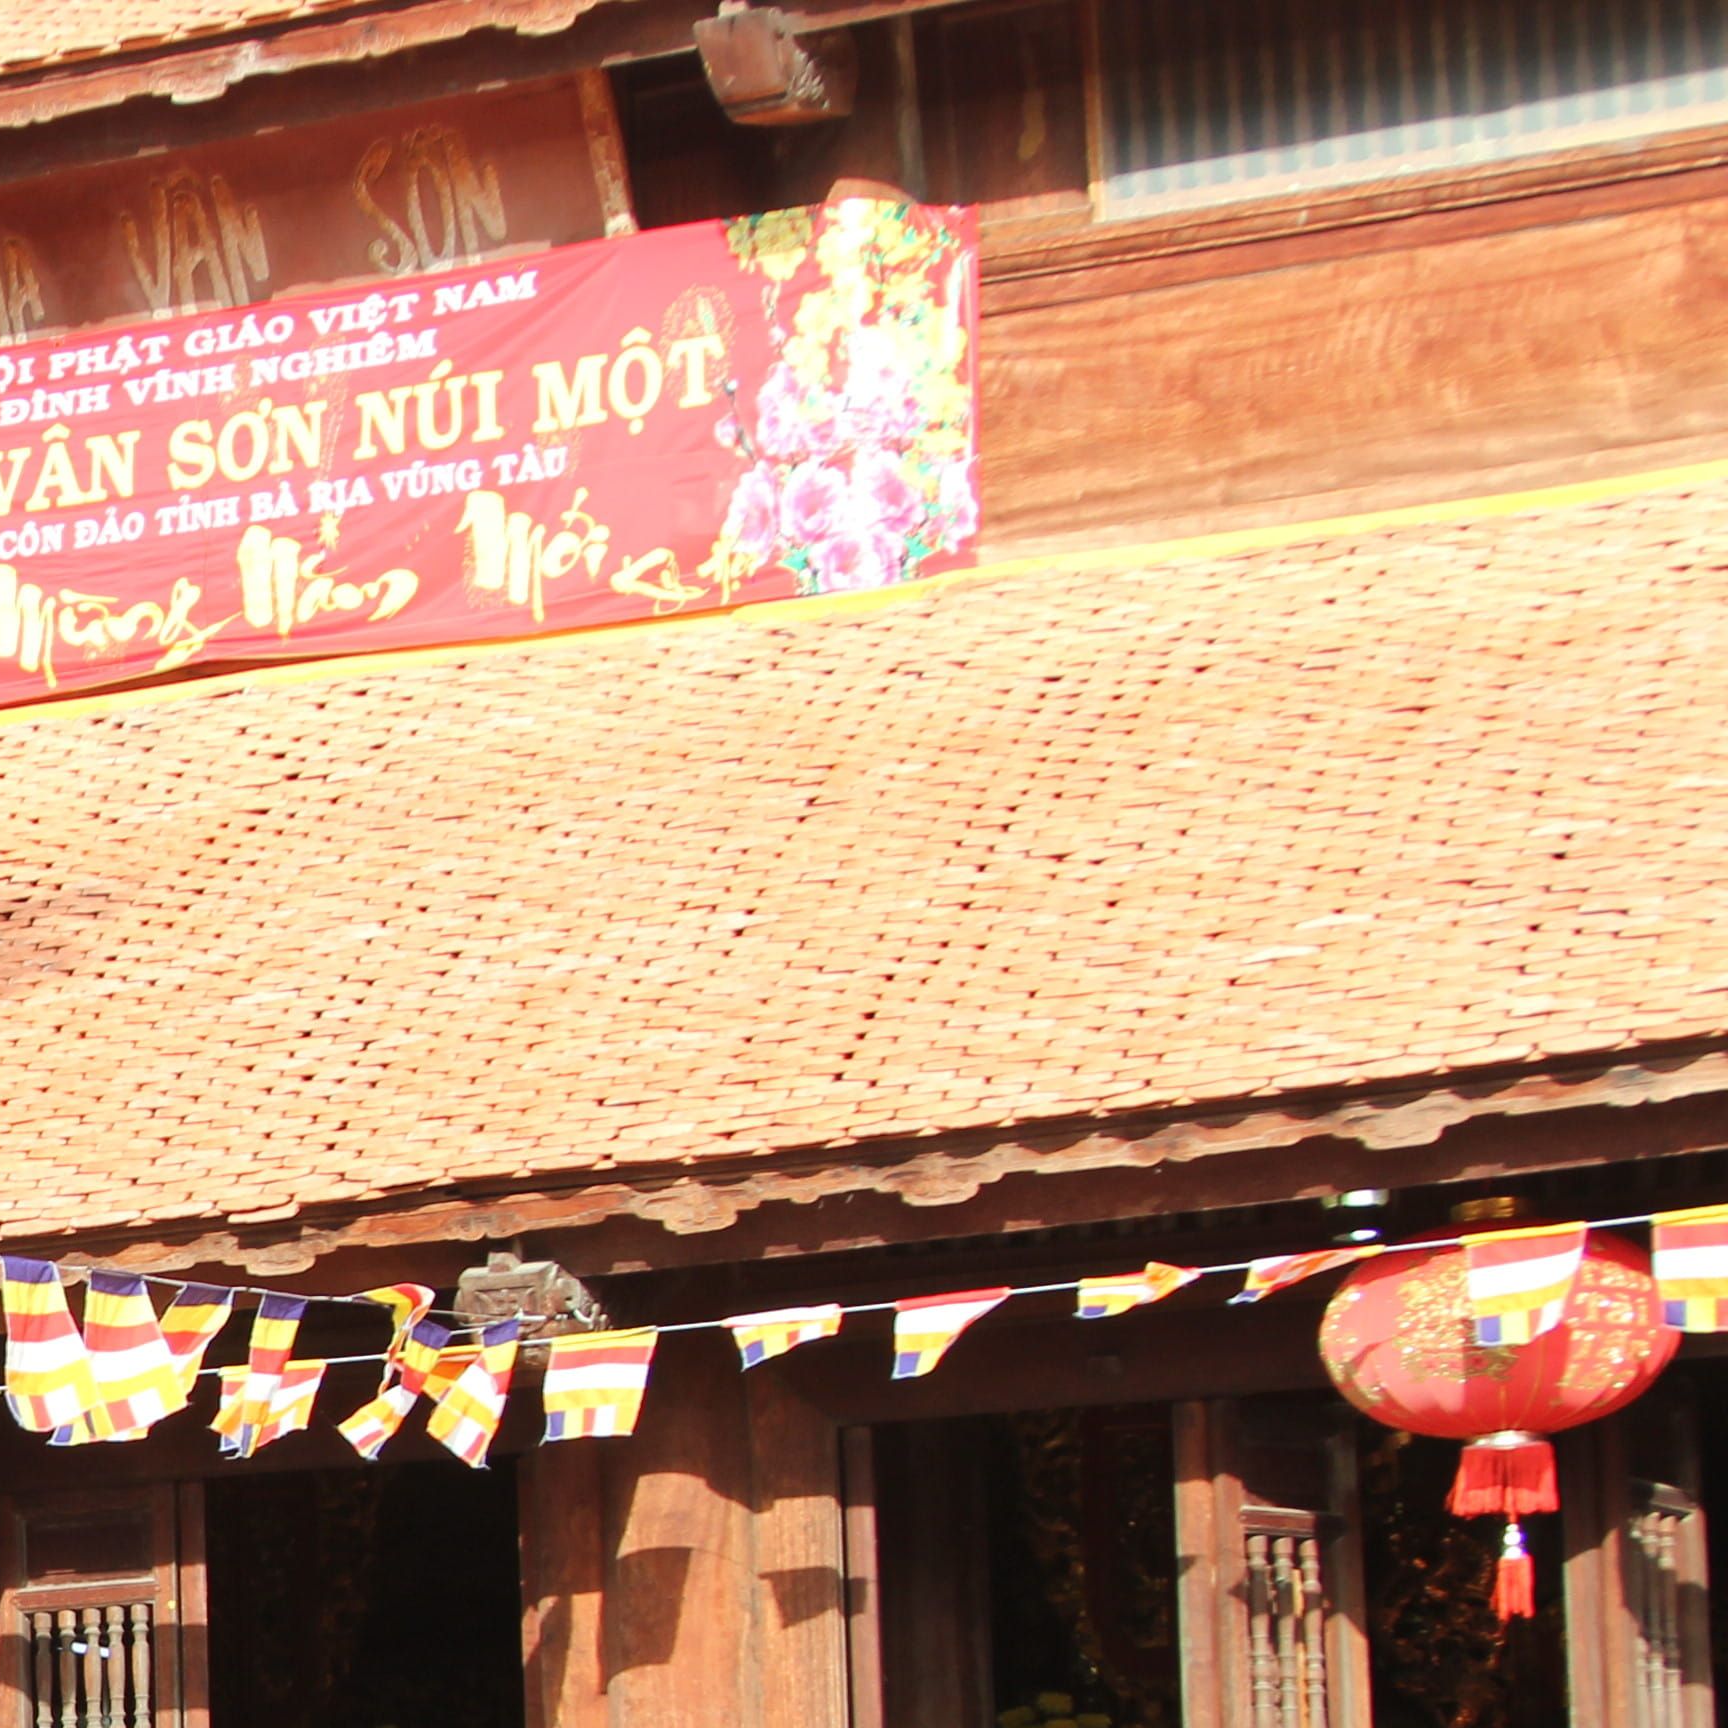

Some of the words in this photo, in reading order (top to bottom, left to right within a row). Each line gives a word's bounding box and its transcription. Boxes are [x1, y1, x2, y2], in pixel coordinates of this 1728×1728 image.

[48, 332, 170, 377] PHẬT
[183, 312, 295, 357] GIÁO
[307, 293, 420, 336] VIỆT
[432, 270, 538, 316] NAM
[249, 329, 438, 388] NGHIÊM
[166, 396, 328, 492] SƠN
[352, 359, 505, 462] NÚI
[532, 326, 726, 436] MỘT
[73, 506, 145, 549] ĐẢO
[249, 480, 300, 522] BÀ
[492, 443, 569, 486] TÀU
[236, 524, 420, 637] Năm
[454, 487, 611, 623] Mới
